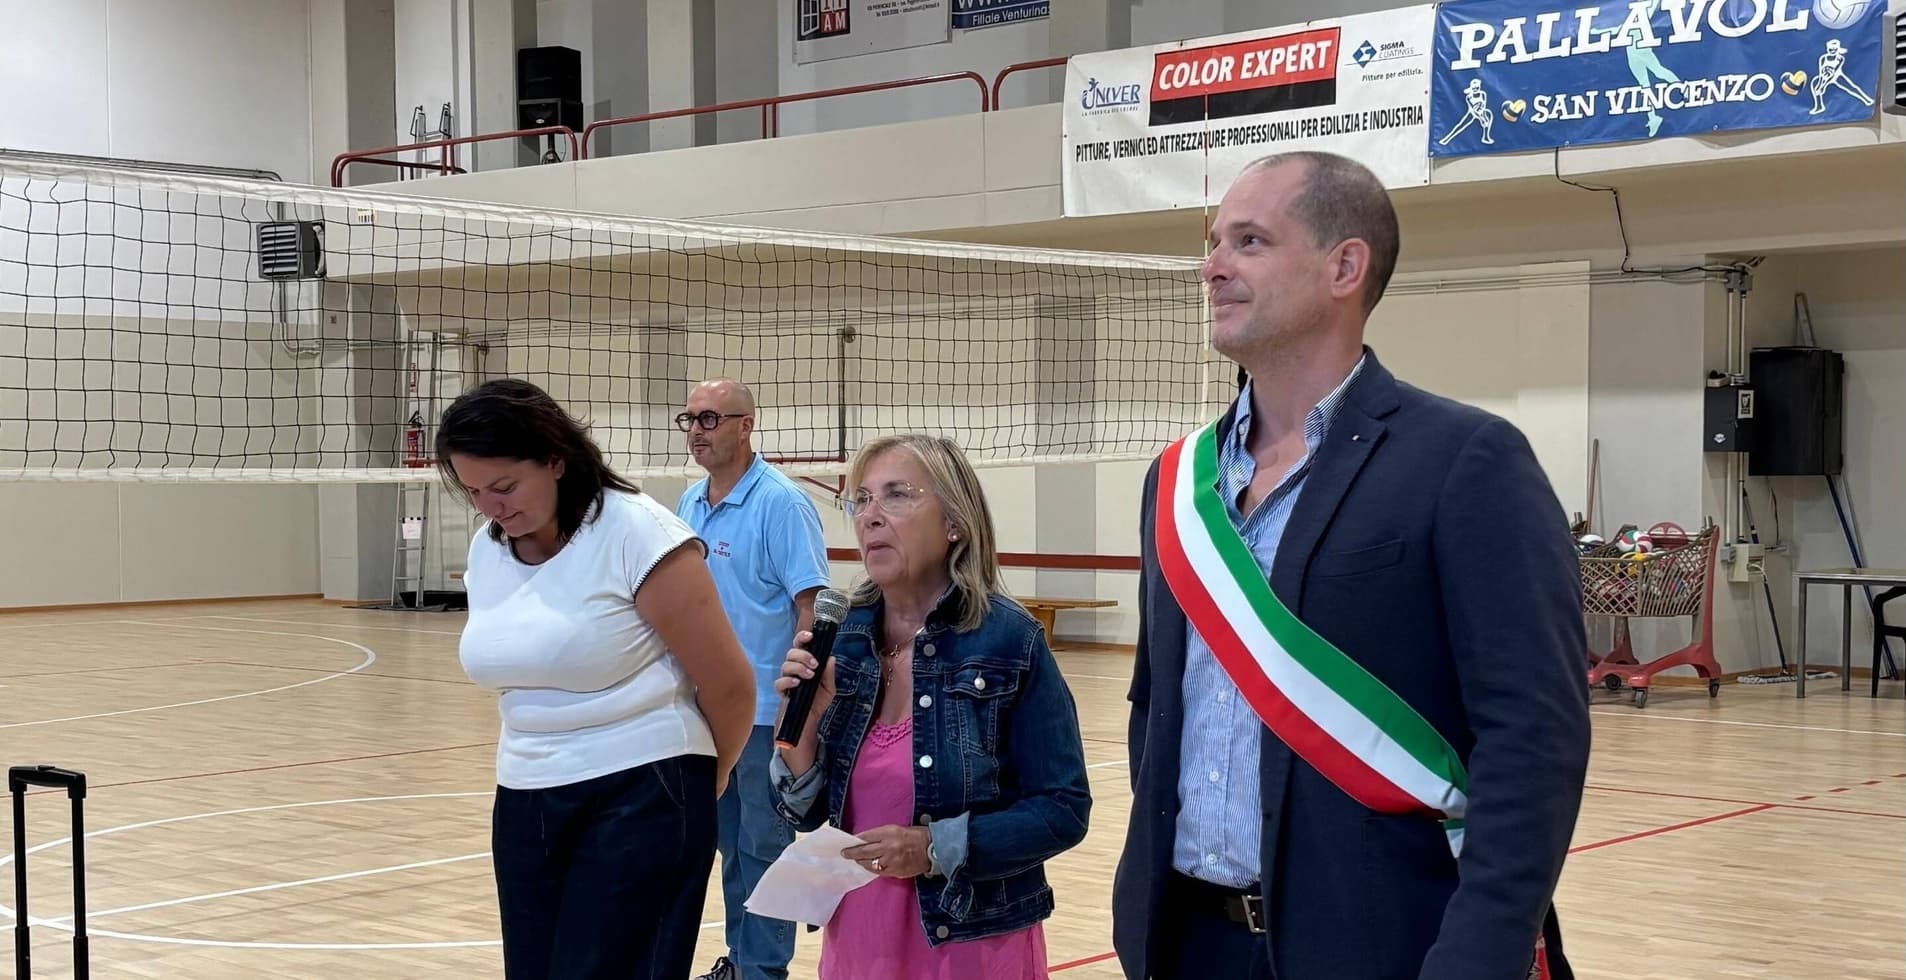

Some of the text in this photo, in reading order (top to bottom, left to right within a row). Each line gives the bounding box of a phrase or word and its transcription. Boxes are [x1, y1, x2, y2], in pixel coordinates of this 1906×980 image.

[823, 12, 847, 31] AM
[972, 6, 1048, 25] Filiale Venturina
[1380, 41, 1405, 51] SIGMA
[1158, 40, 1332, 91] COLOR EXPERT
[1082, 84, 1141, 110] UNIVER
[1531, 73, 1775, 123] SAN VINCENZO
[1075, 105, 1424, 163] PITTURE, VERNICI ED ATTREZZATURE PROFESSIONALI PER EDILIZIA E INDUSTRIA
